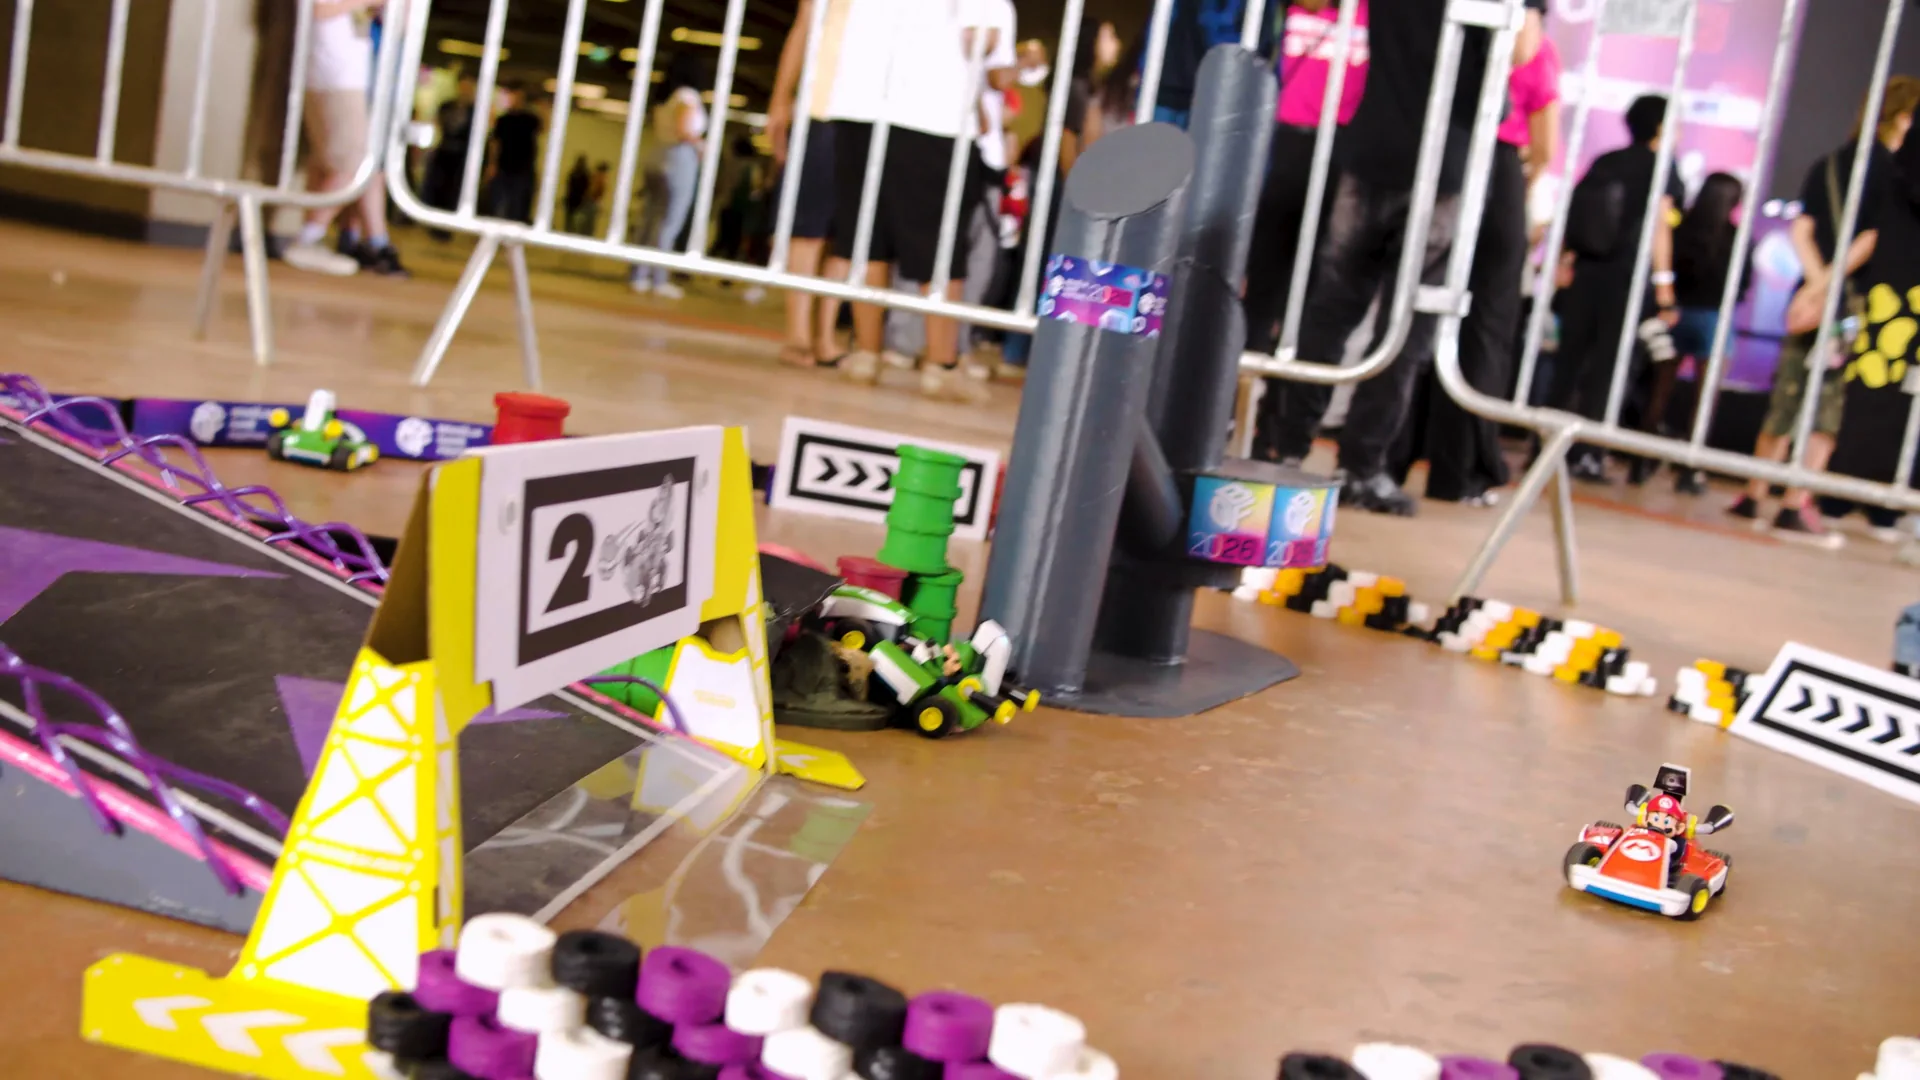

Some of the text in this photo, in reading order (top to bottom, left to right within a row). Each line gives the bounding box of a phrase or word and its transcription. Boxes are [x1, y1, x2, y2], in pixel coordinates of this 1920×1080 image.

[1190, 531, 1256, 561] 2026
[543, 513, 594, 615] 2
[1625, 842, 1654, 857] M
